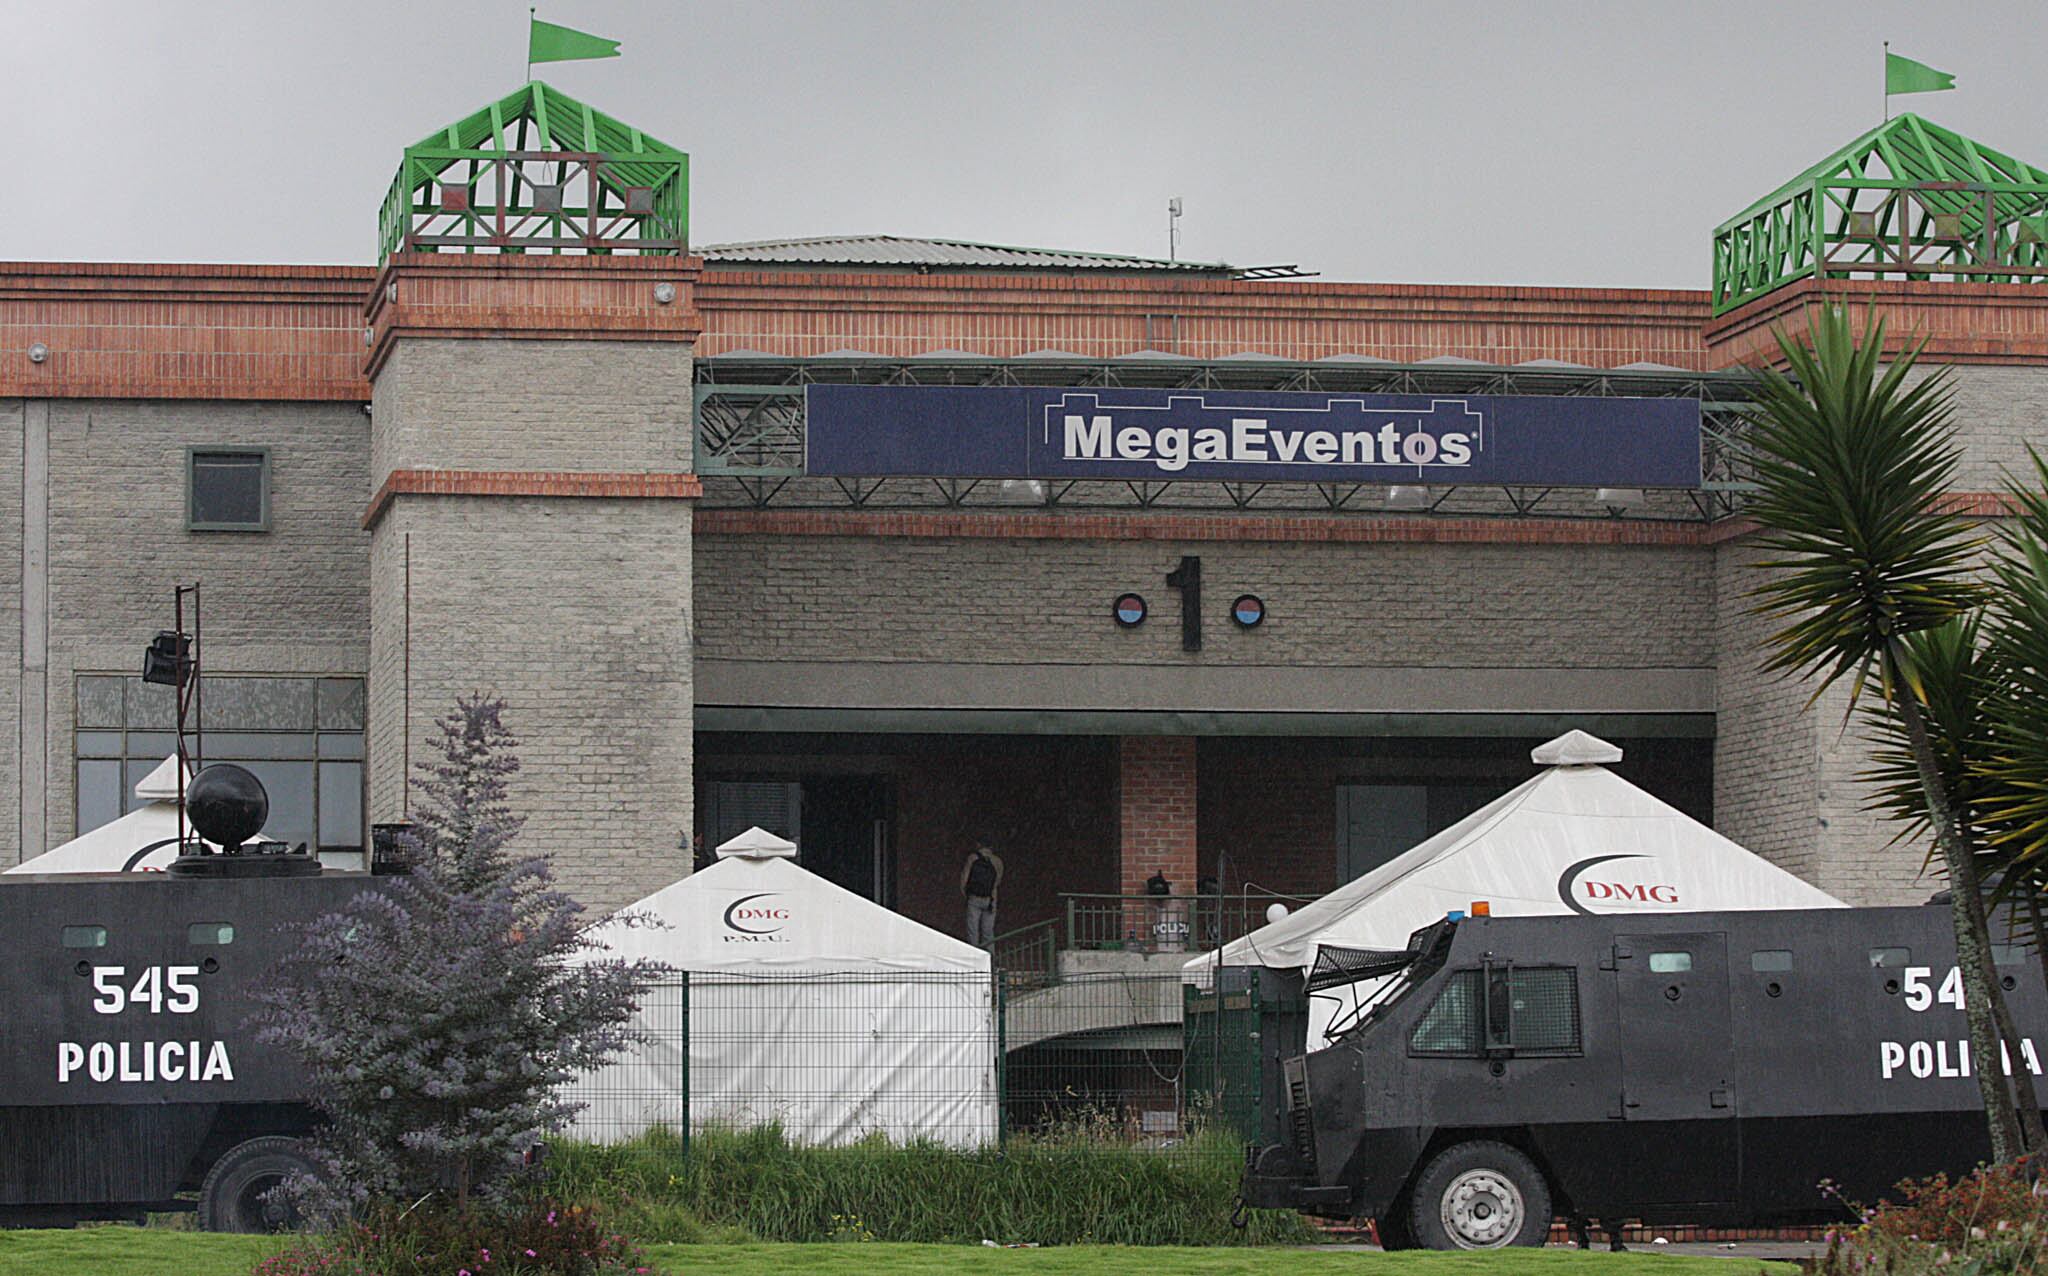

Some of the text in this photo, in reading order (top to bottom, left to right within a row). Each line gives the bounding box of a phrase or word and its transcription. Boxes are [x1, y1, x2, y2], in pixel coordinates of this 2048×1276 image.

[1064, 415, 1471, 470] MegaEventos
[1166, 556, 1201, 652] 1
[1585, 881, 1679, 903] DMG
[738, 909, 789, 919] DMG
[93, 966, 199, 1014] 545
[1904, 966, 1992, 1012] 54
[58, 1041, 234, 1082] POLICIA
[1881, 1038, 2043, 1079] POLIIA
